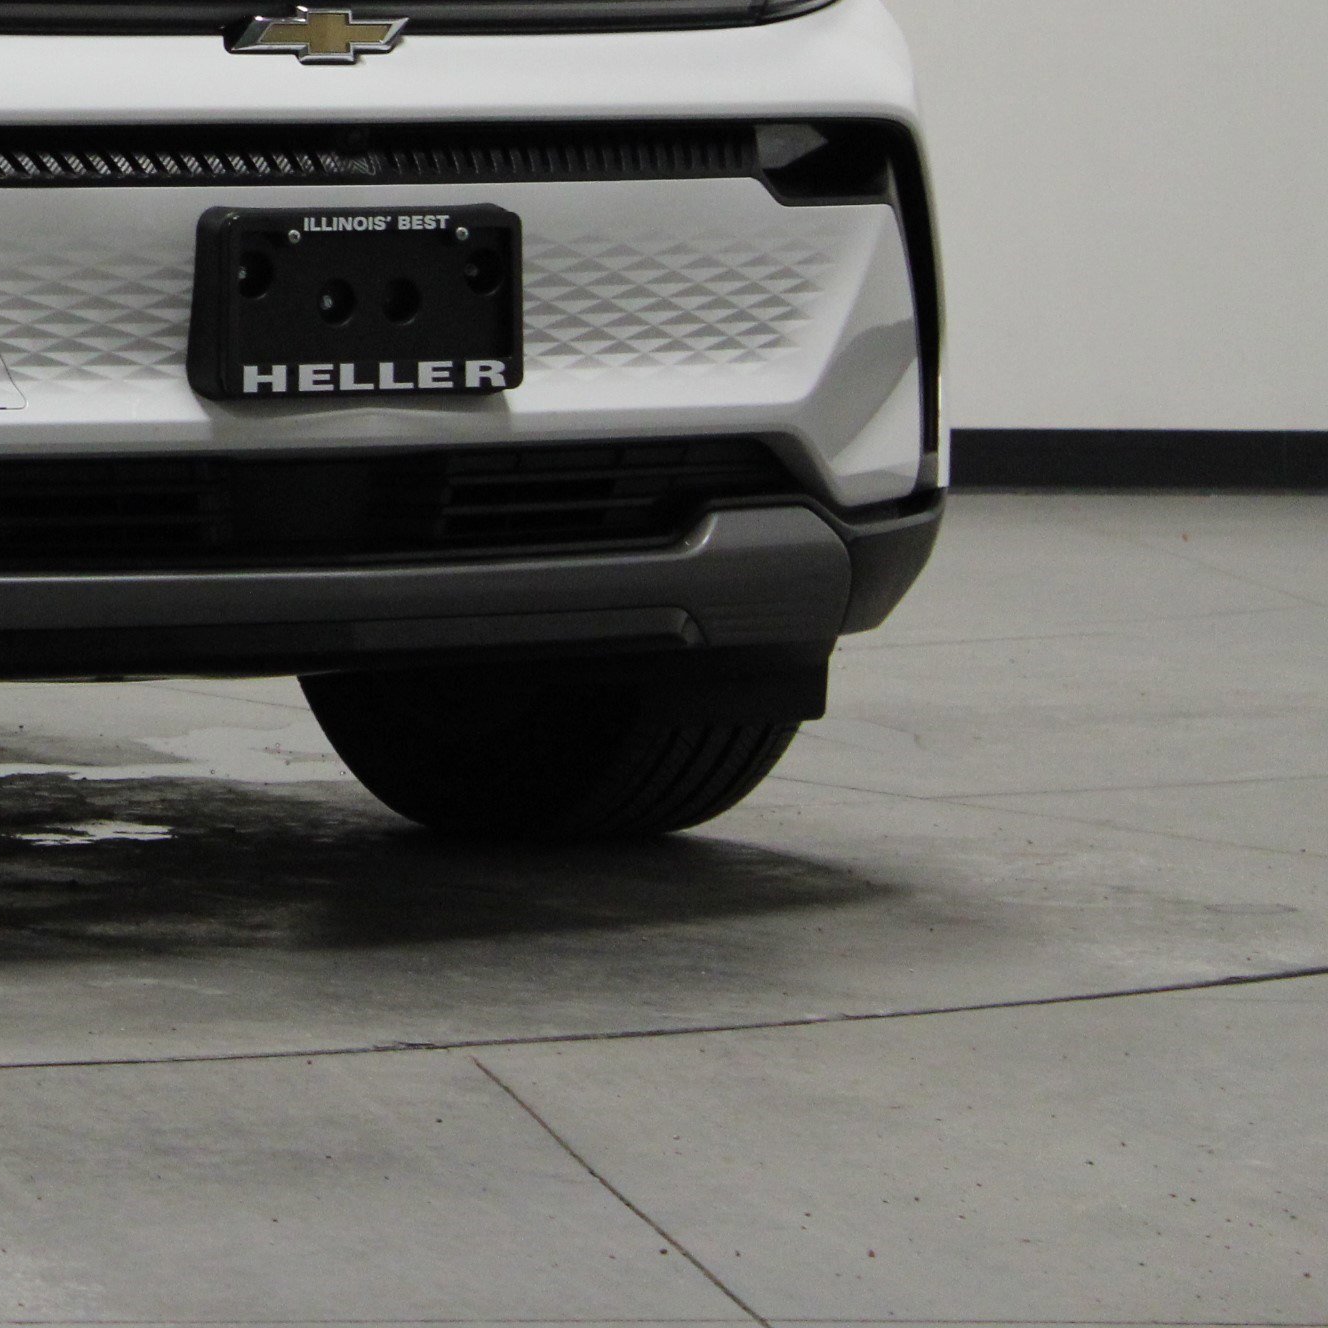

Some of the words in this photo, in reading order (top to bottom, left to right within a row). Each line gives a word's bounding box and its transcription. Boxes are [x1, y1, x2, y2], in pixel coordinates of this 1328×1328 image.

[303, 216, 392, 232] ILLINOIS'
[397, 214, 450, 230] BEST
[243, 359, 508, 394] HELLER
